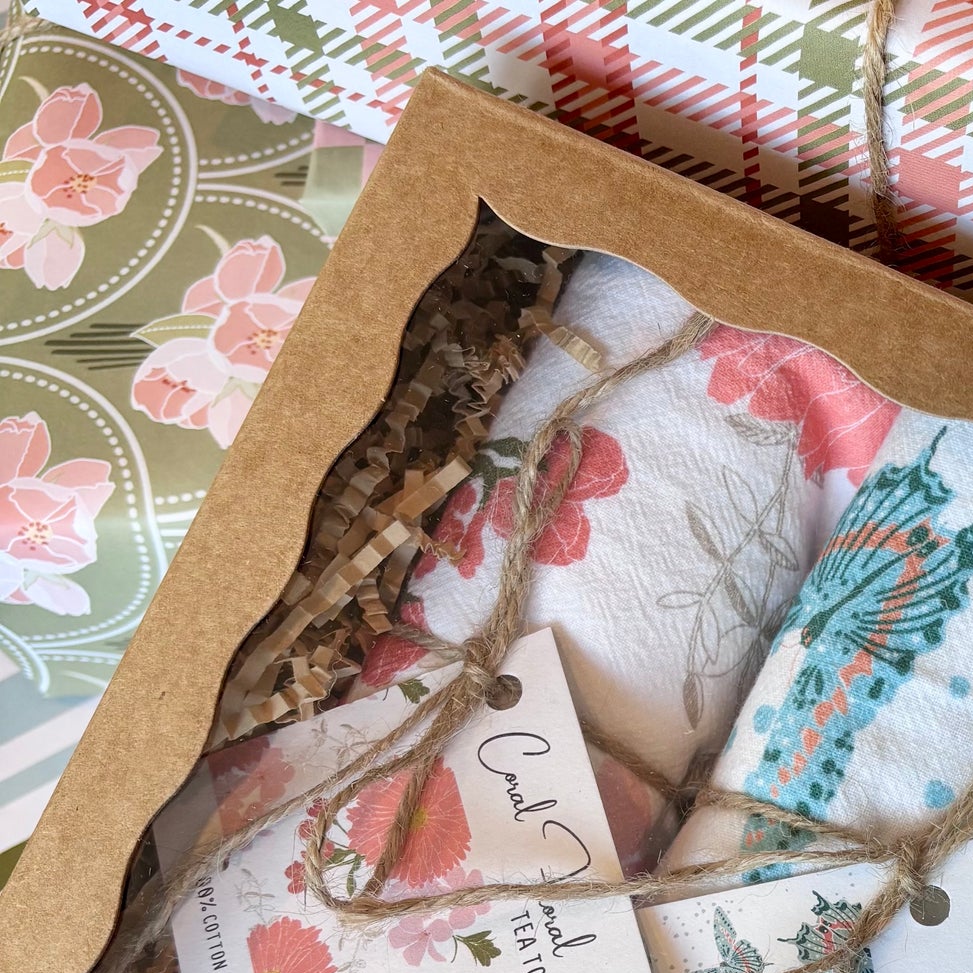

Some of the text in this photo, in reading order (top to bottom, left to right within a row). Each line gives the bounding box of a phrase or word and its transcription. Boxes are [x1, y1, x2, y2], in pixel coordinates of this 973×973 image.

[478, 732, 557, 821] Coral
[196, 875, 217, 912] 00%
[203, 914, 228, 971] COTTON
[511, 910, 537, 951] TEA
